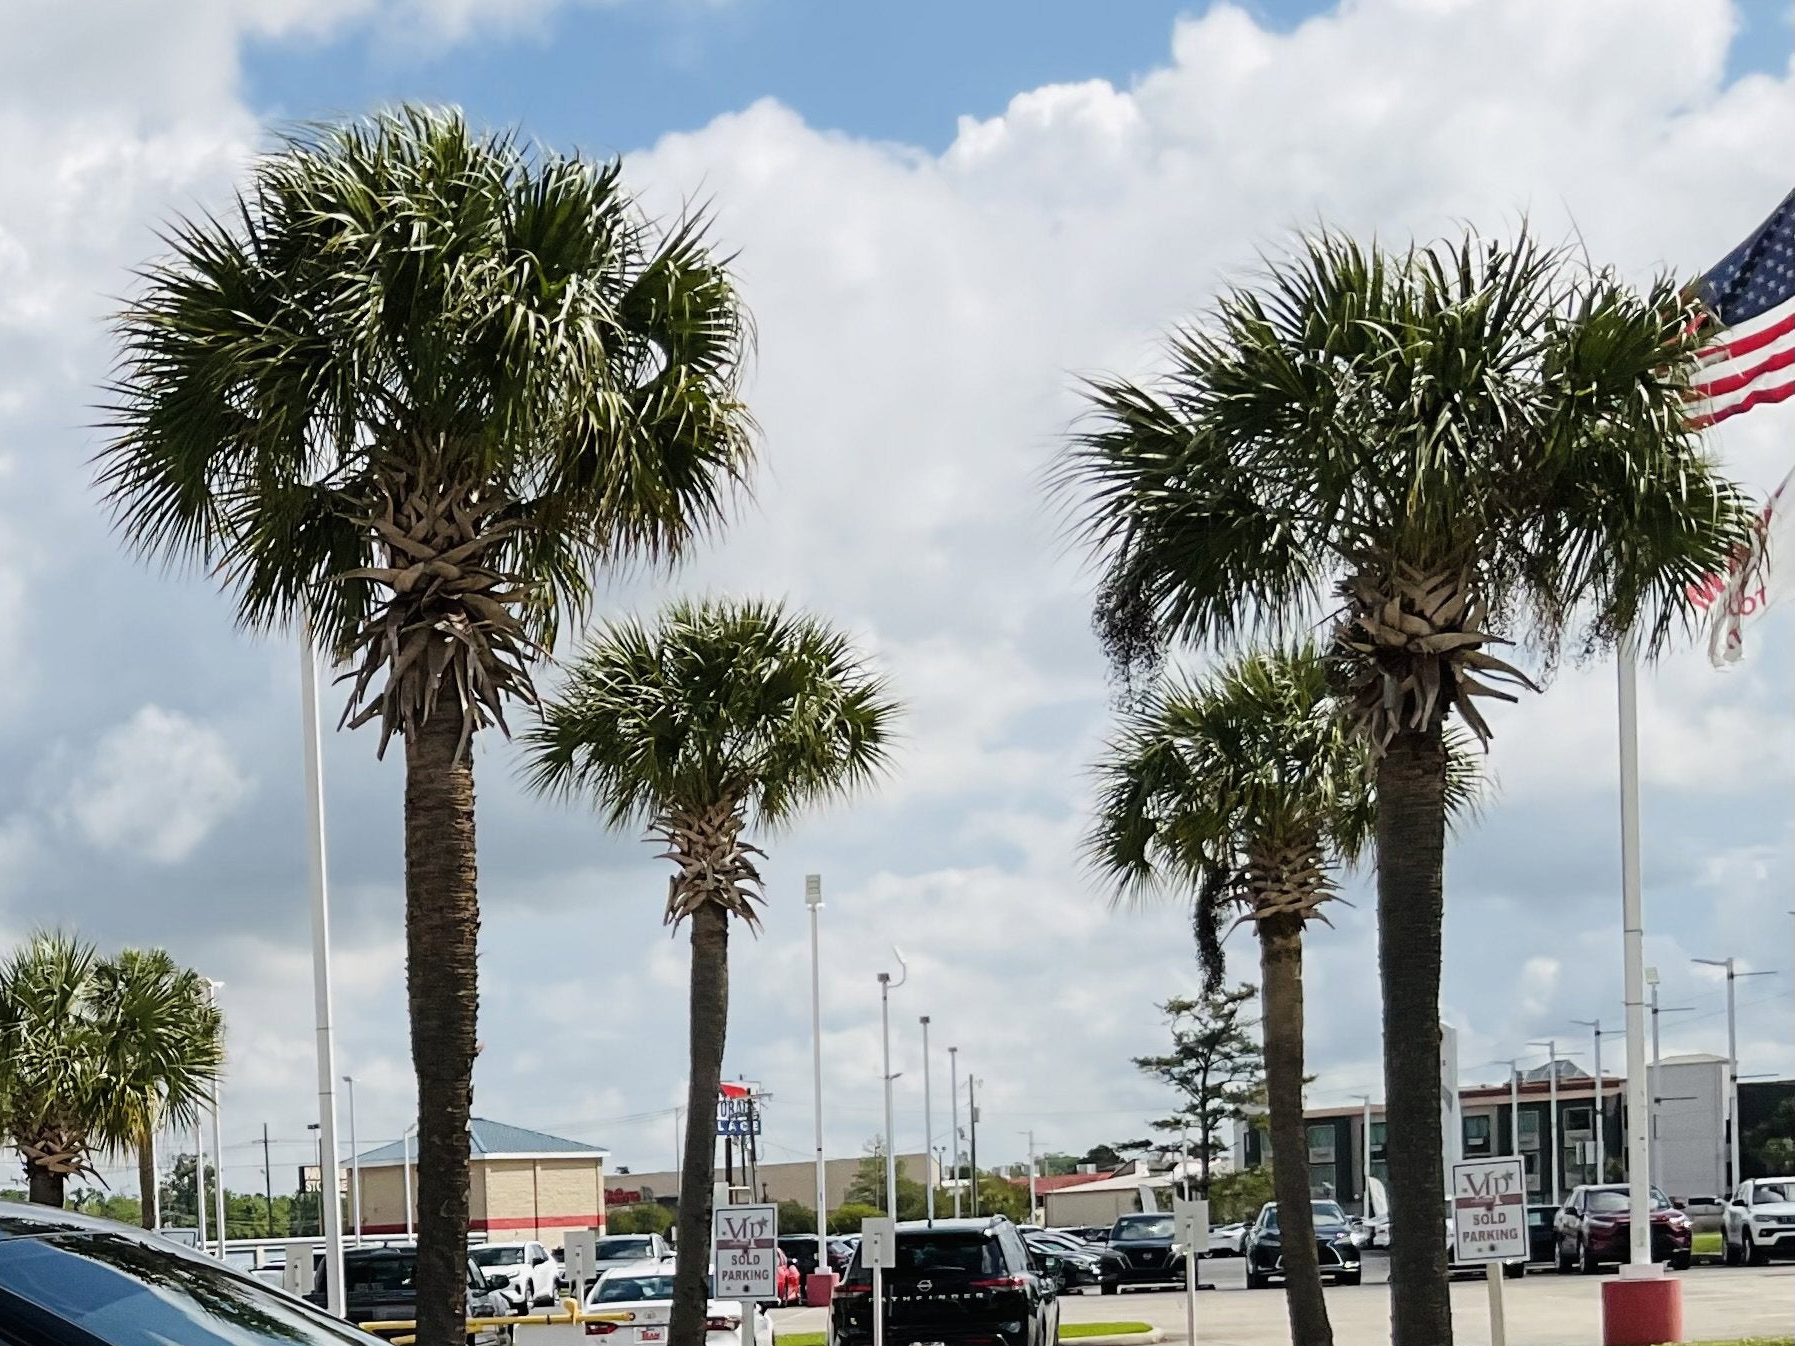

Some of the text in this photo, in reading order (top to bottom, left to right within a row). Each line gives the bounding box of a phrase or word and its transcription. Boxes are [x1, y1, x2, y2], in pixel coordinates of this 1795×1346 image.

[1473, 1212, 1507, 1226] SOLD
[1462, 1228, 1518, 1243] PARKING
[731, 1254, 761, 1266] SOLD
[722, 1269, 770, 1281] PARKING
